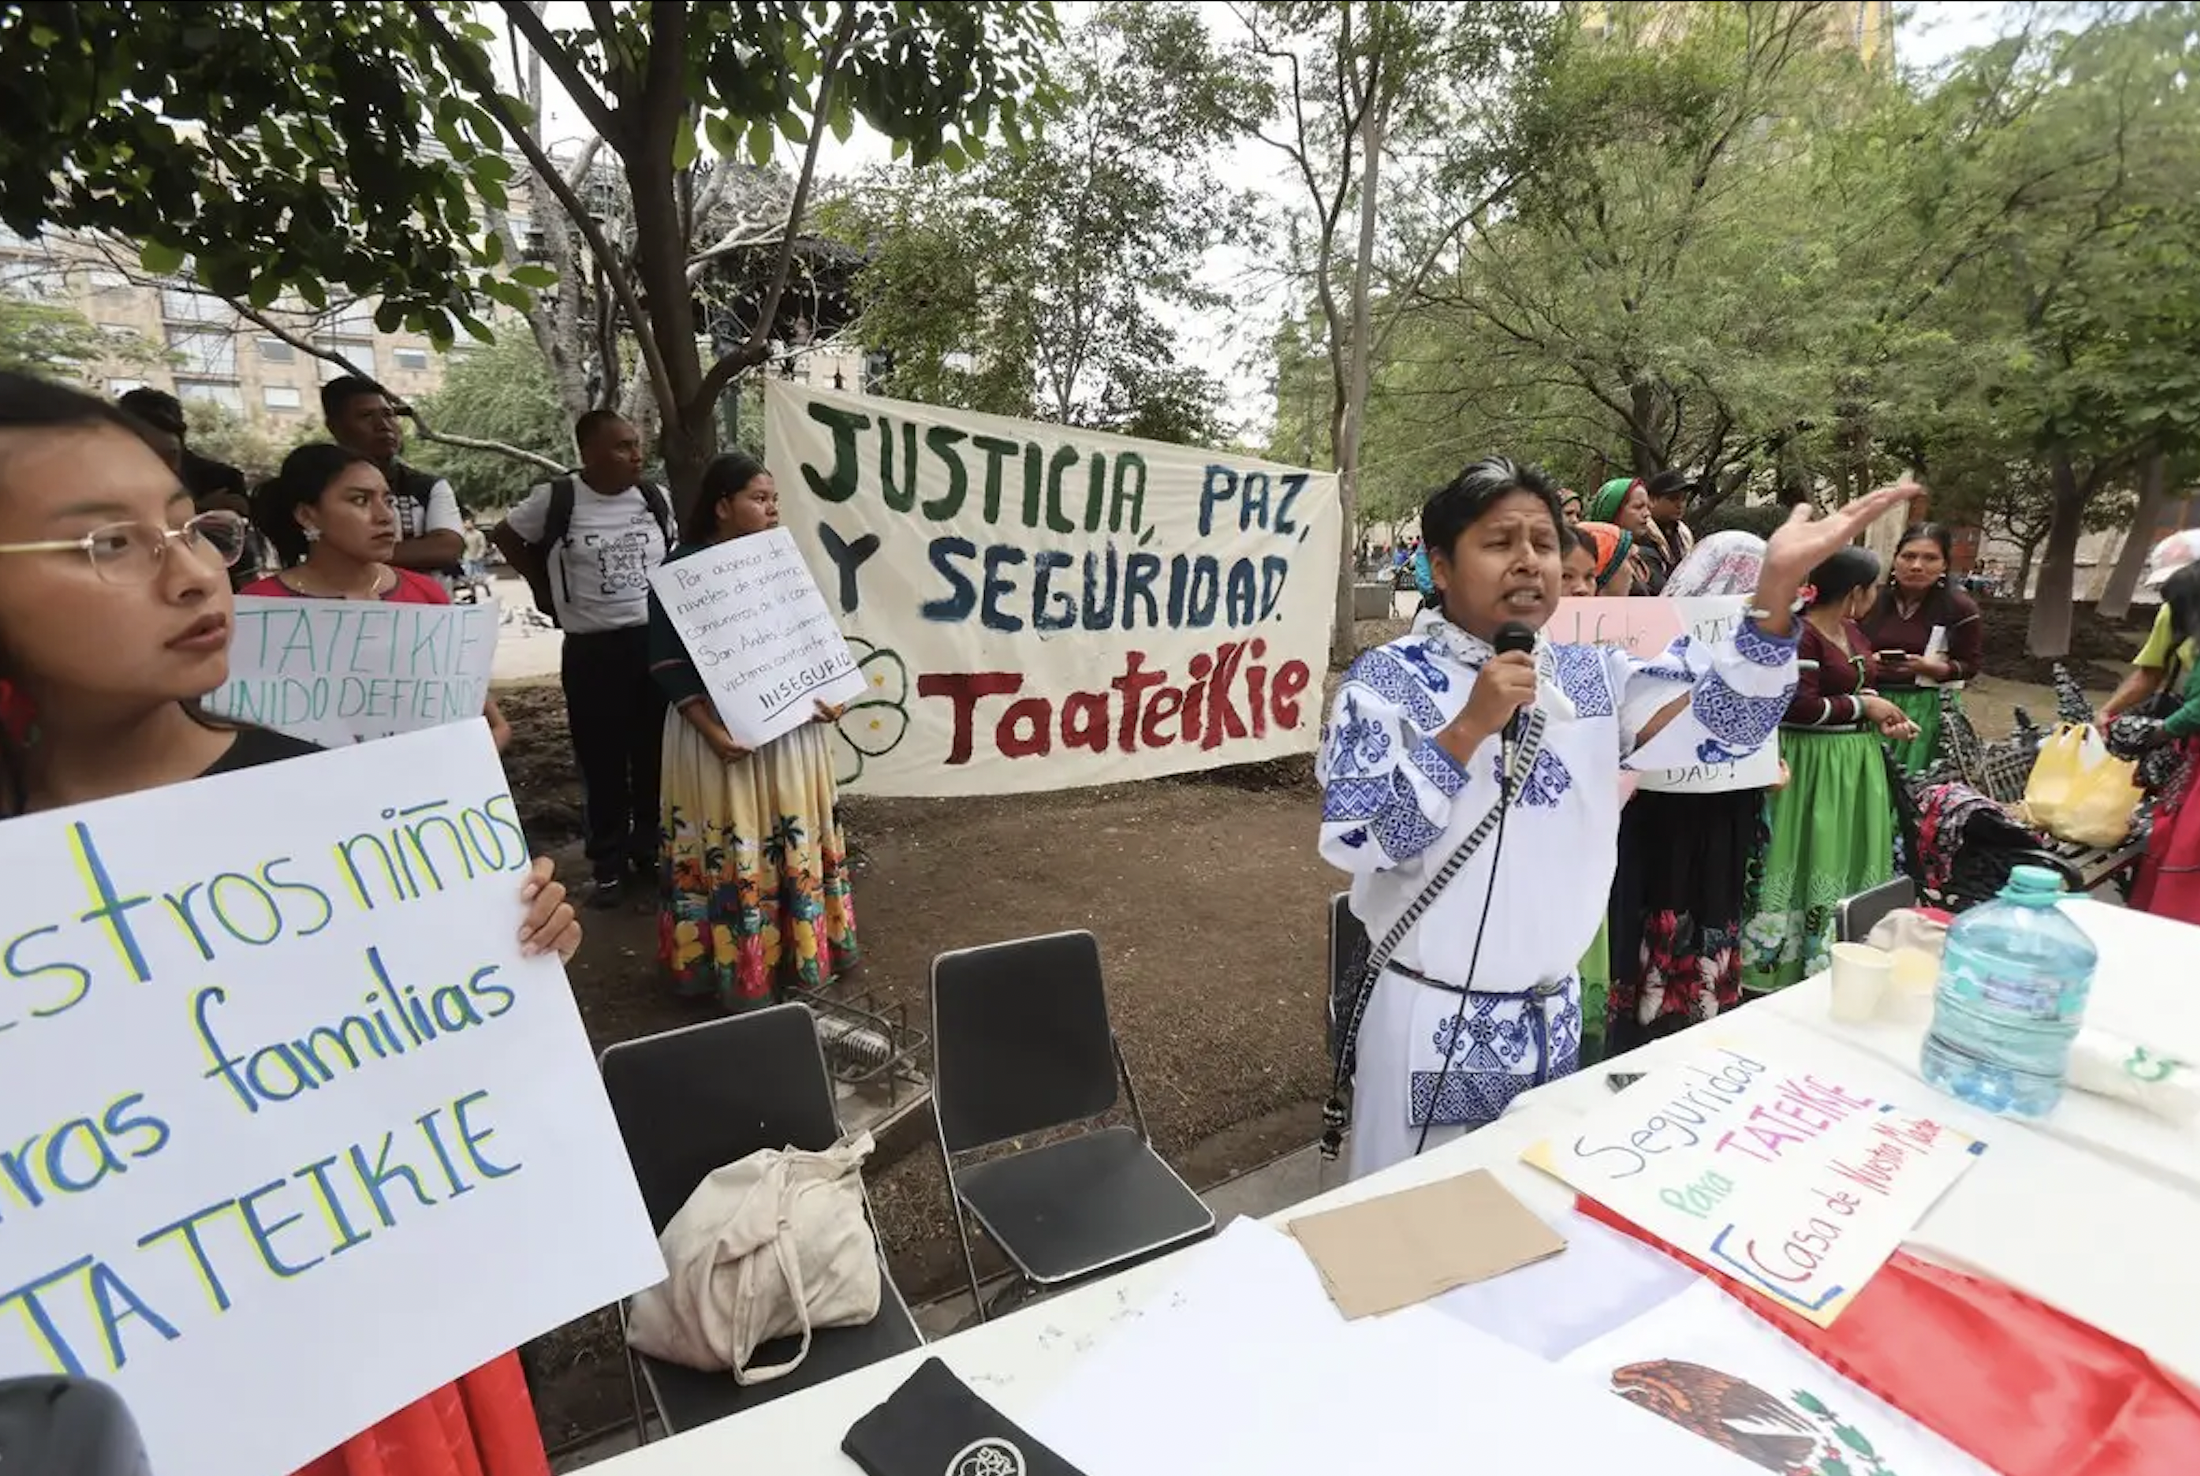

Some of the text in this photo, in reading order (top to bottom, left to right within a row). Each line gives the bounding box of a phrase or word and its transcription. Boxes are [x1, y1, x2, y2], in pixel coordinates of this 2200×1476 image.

[800, 401, 1311, 547] JUSTICIA, PAZ,
[817, 521, 880, 613] Y
[236, 608, 485, 676] TATEIKIE
[0, 792, 531, 1032] stros niños
[189, 946, 517, 1115] familias
[1573, 1047, 1767, 1179] Seguridad
[1658, 1169, 1736, 1219] Para
[1746, 1215, 1841, 1283] Casa
[1810, 1186, 1862, 1216] de
